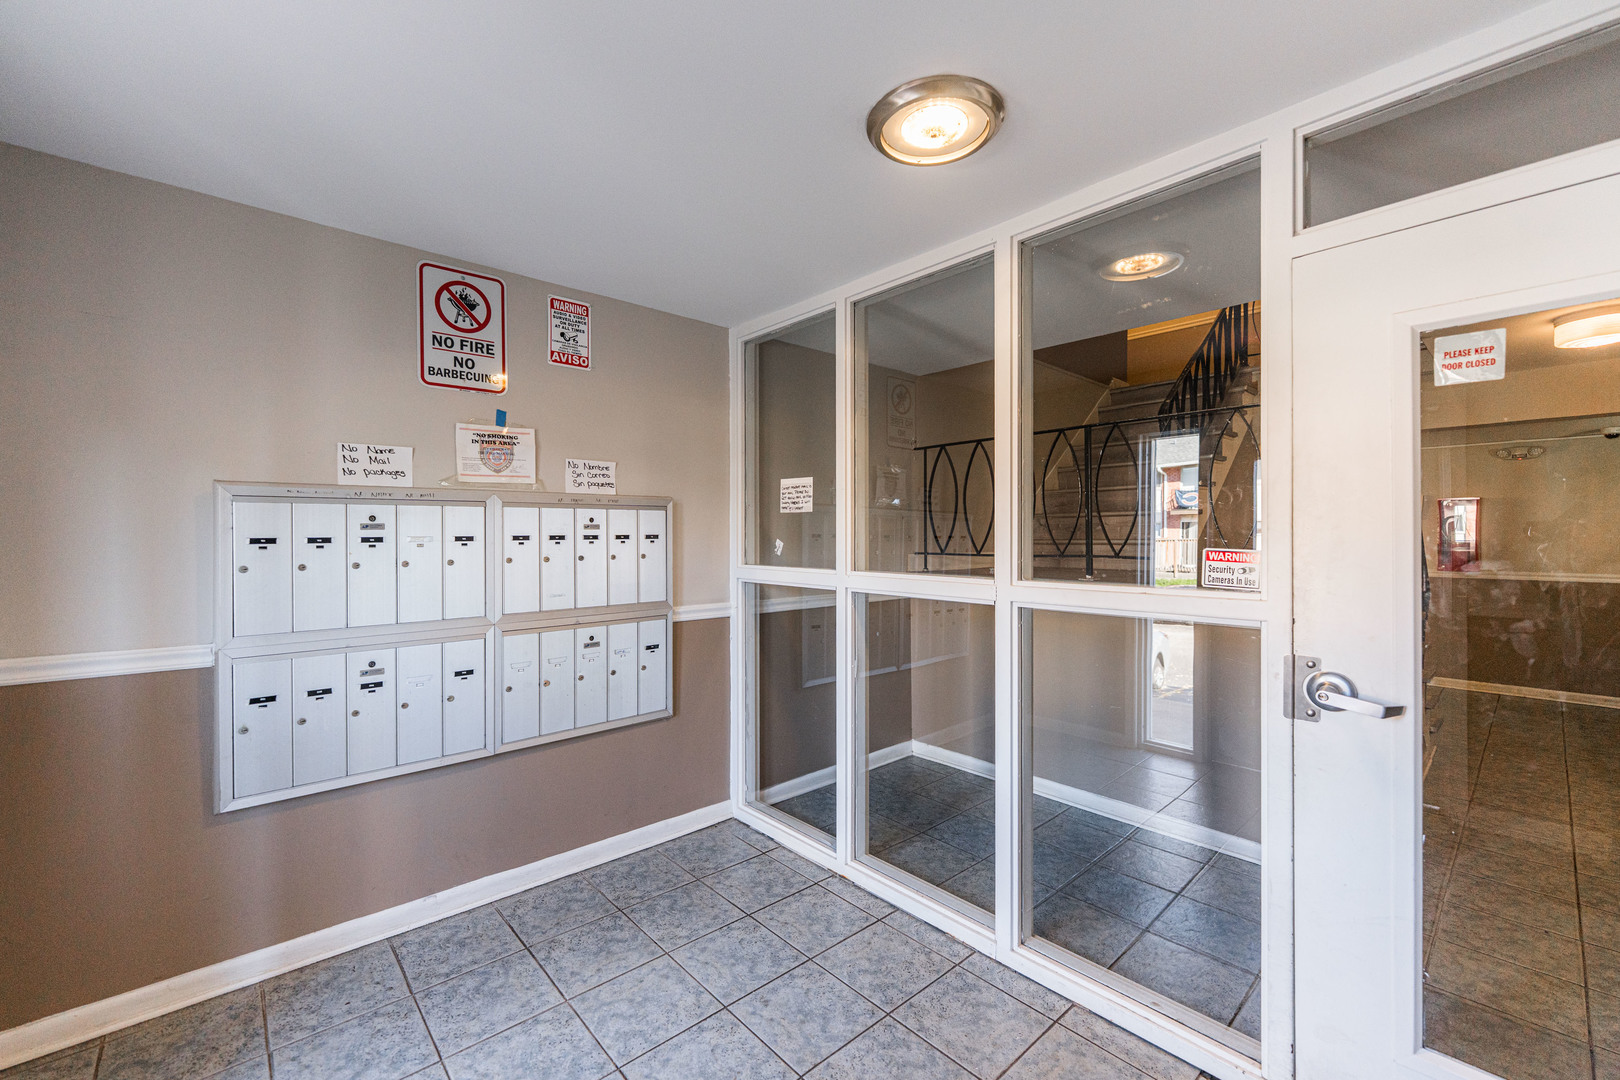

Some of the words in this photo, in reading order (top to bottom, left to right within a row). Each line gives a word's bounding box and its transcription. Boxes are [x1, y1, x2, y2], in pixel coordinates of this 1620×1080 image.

[553, 299, 587, 316] WARNING
[553, 314, 587, 326] SURVEILLANCE
[432, 334, 455, 349] NO
[460, 339, 495, 356] FIRE
[1443, 348, 1472, 359] PLEASE
[1474, 345, 1495, 355] KEEP
[453, 355, 476, 370] NO
[552, 351, 588, 367] AVISO
[1441, 361, 1463, 371] DOOR
[1465, 358, 1496, 369] CLOSED
[428, 365, 500, 385] BARBECUING
[487, 433, 519, 441] SMOKING
[341, 443, 358, 453] No
[367, 445, 396, 455] Name
[342, 454, 359, 464] No
[368, 455, 391, 465] Mail
[567, 460, 579, 469] No
[342, 467, 357, 476] No
[363, 468, 406, 480] packages
[1207, 564, 1236, 576] Security
[1207, 575, 1235, 585] Cameras
[1236, 576, 1243, 585] In
[1244, 577, 1256, 587] Use
